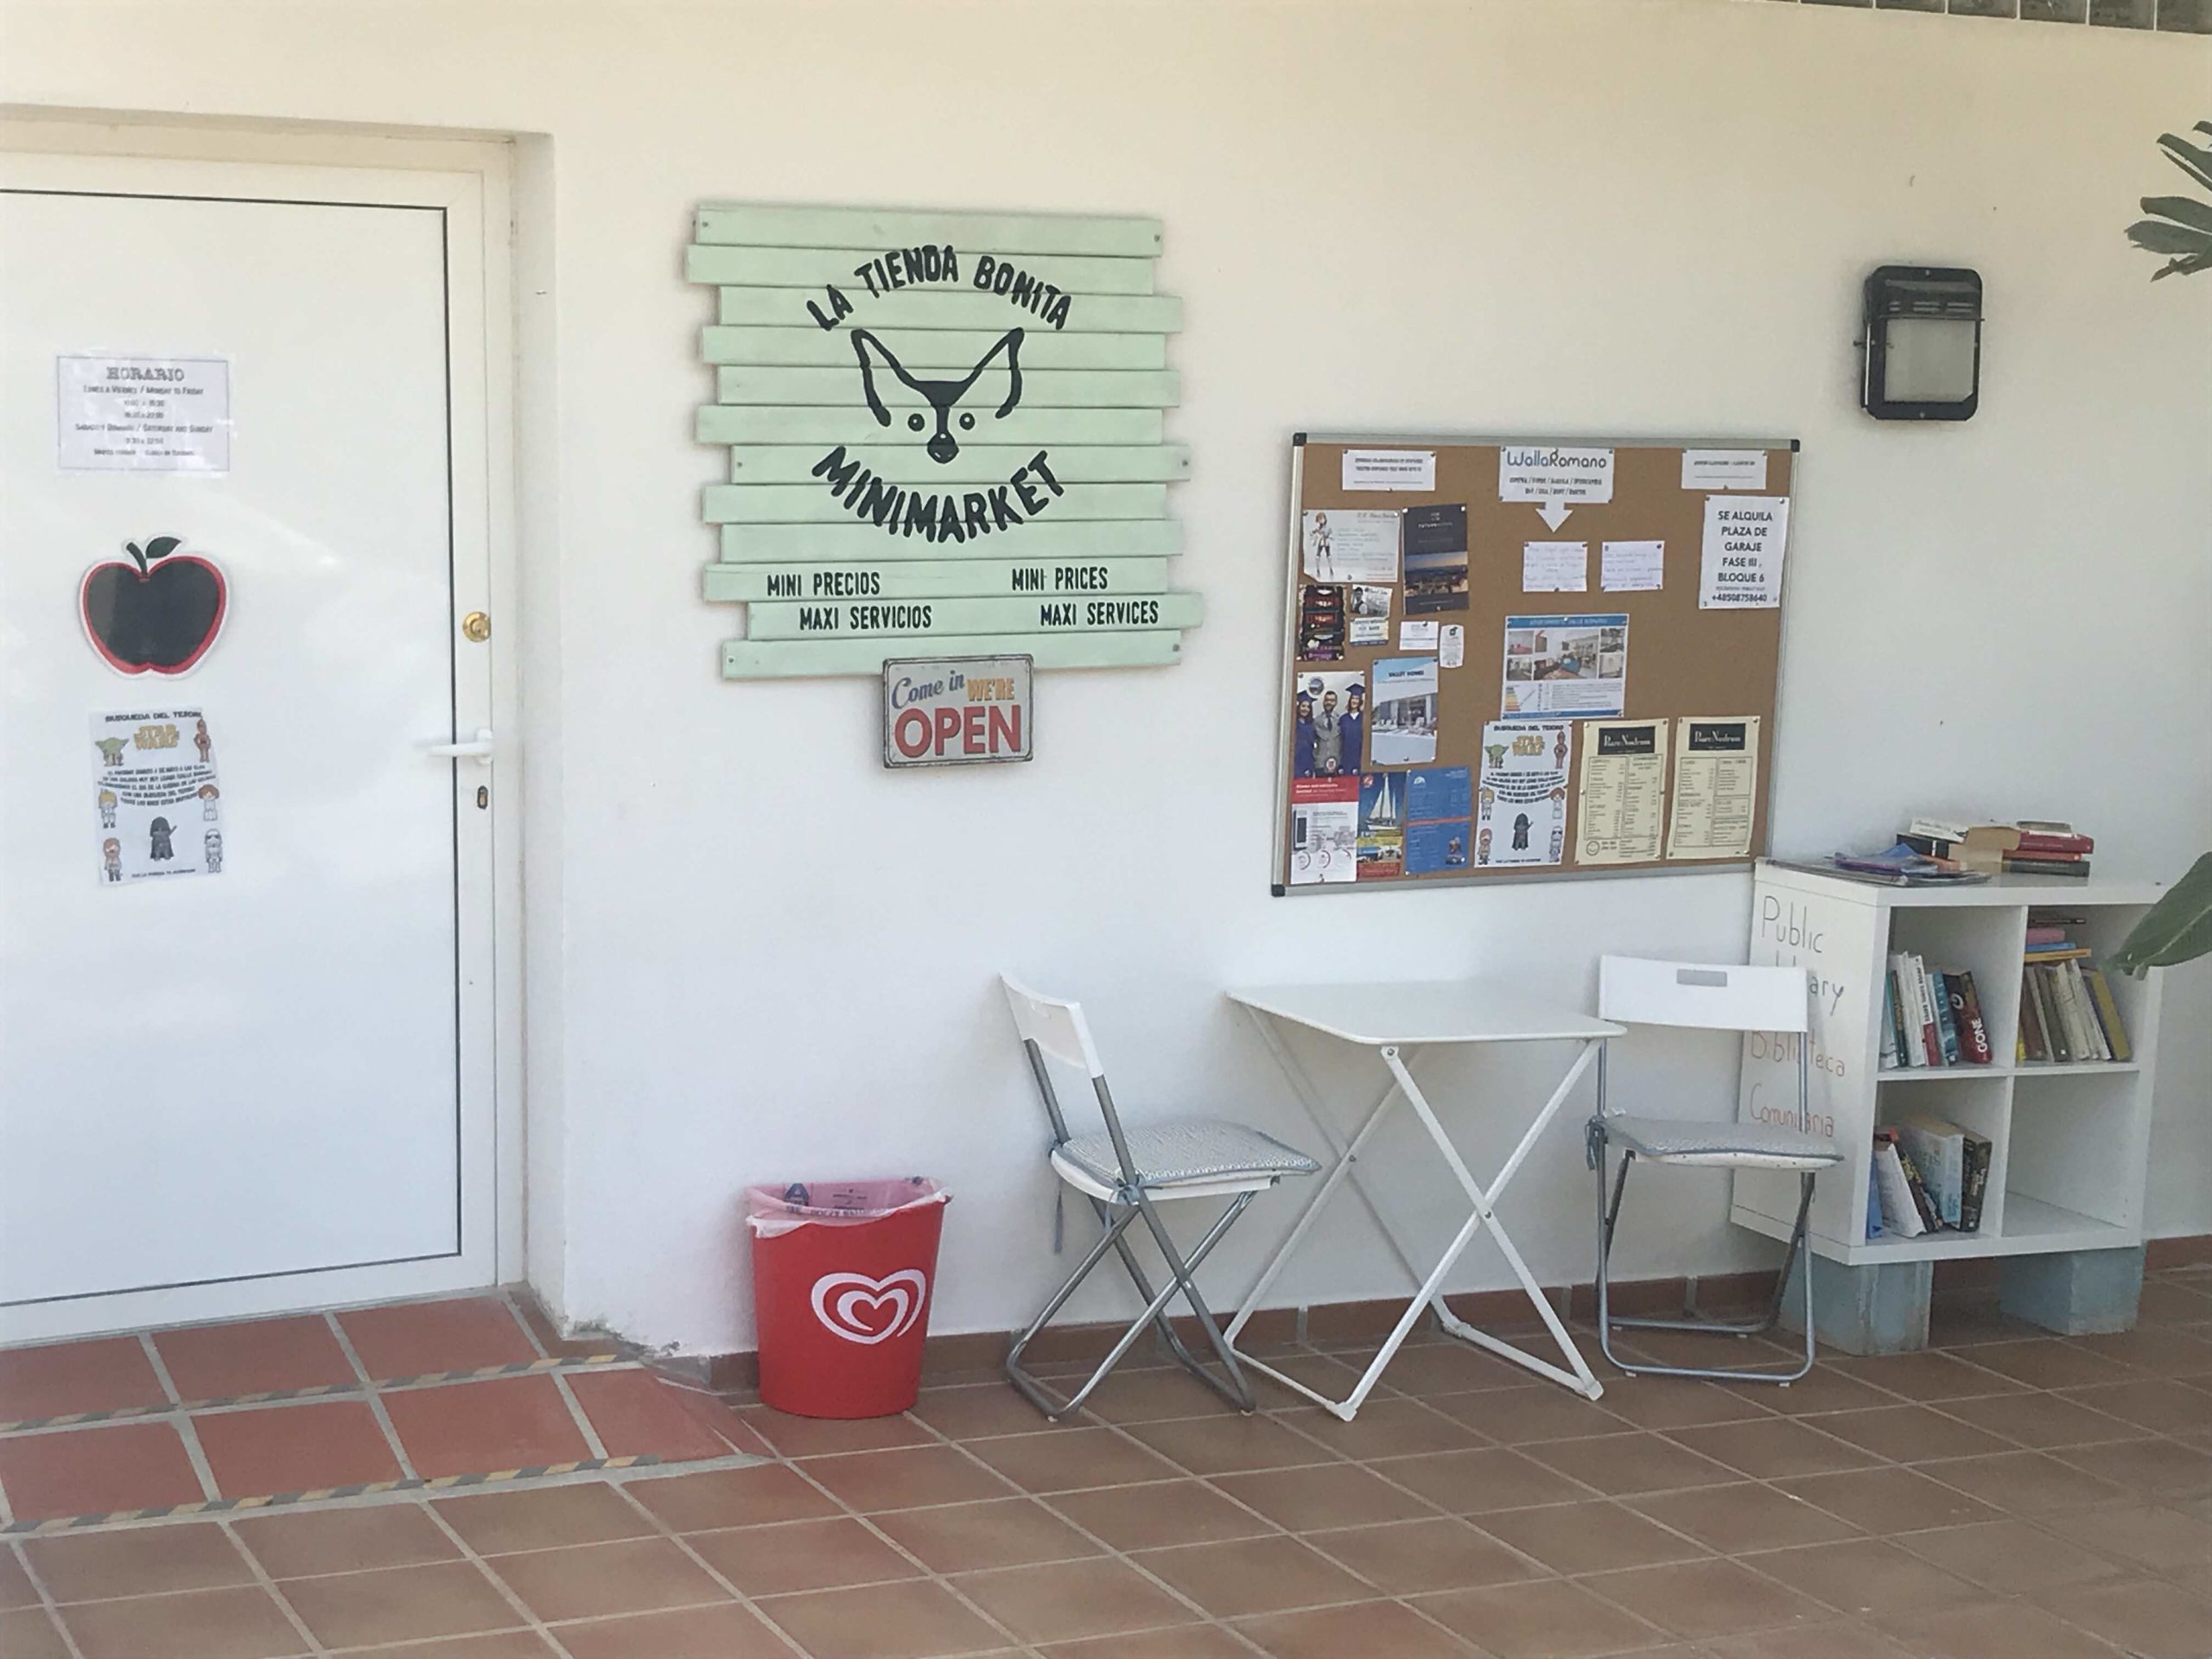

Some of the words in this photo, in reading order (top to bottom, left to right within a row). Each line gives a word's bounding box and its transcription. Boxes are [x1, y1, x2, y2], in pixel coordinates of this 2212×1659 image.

[807, 284, 853, 331] LA
[854, 245, 958, 298] TIENDA
[973, 256, 1071, 330] BONITA
[106, 367, 185, 381] HORARIO
[1507, 449, 1607, 467] WallaRomano
[811, 446, 1065, 543] MINIMARKET
[1718, 511, 1729, 520] SE
[1732, 511, 1773, 522] ALQUILA
[1721, 526, 1751, 537] PLAZA
[1754, 527, 1767, 537] DE
[1725, 542, 1762, 552] GARAJE
[1722, 557, 1745, 567] FASE
[767, 575, 802, 597] MINI
[813, 572, 880, 596] PRECIOS
[1012, 568, 1046, 591] MINI
[1055, 567, 1108, 590] PRICES
[1718, 573, 1757, 582] BLOQUE
[1759, 573, 1764, 582] 6
[799, 607, 839, 630] MAXI
[850, 605, 932, 629] SERVICIOS
[1040, 602, 1077, 626] MAXI
[1087, 601, 1159, 624] SERVICES
[891, 676, 944, 709] Come
[949, 671, 964, 691] in
[967, 677, 1015, 701] WE'RE
[894, 704, 1021, 758] OPEN
[1762, 896, 1823, 953] Public
[1971, 1017, 1988, 1052] GONE
[1751, 1028, 1845, 1077] Bibliteca
